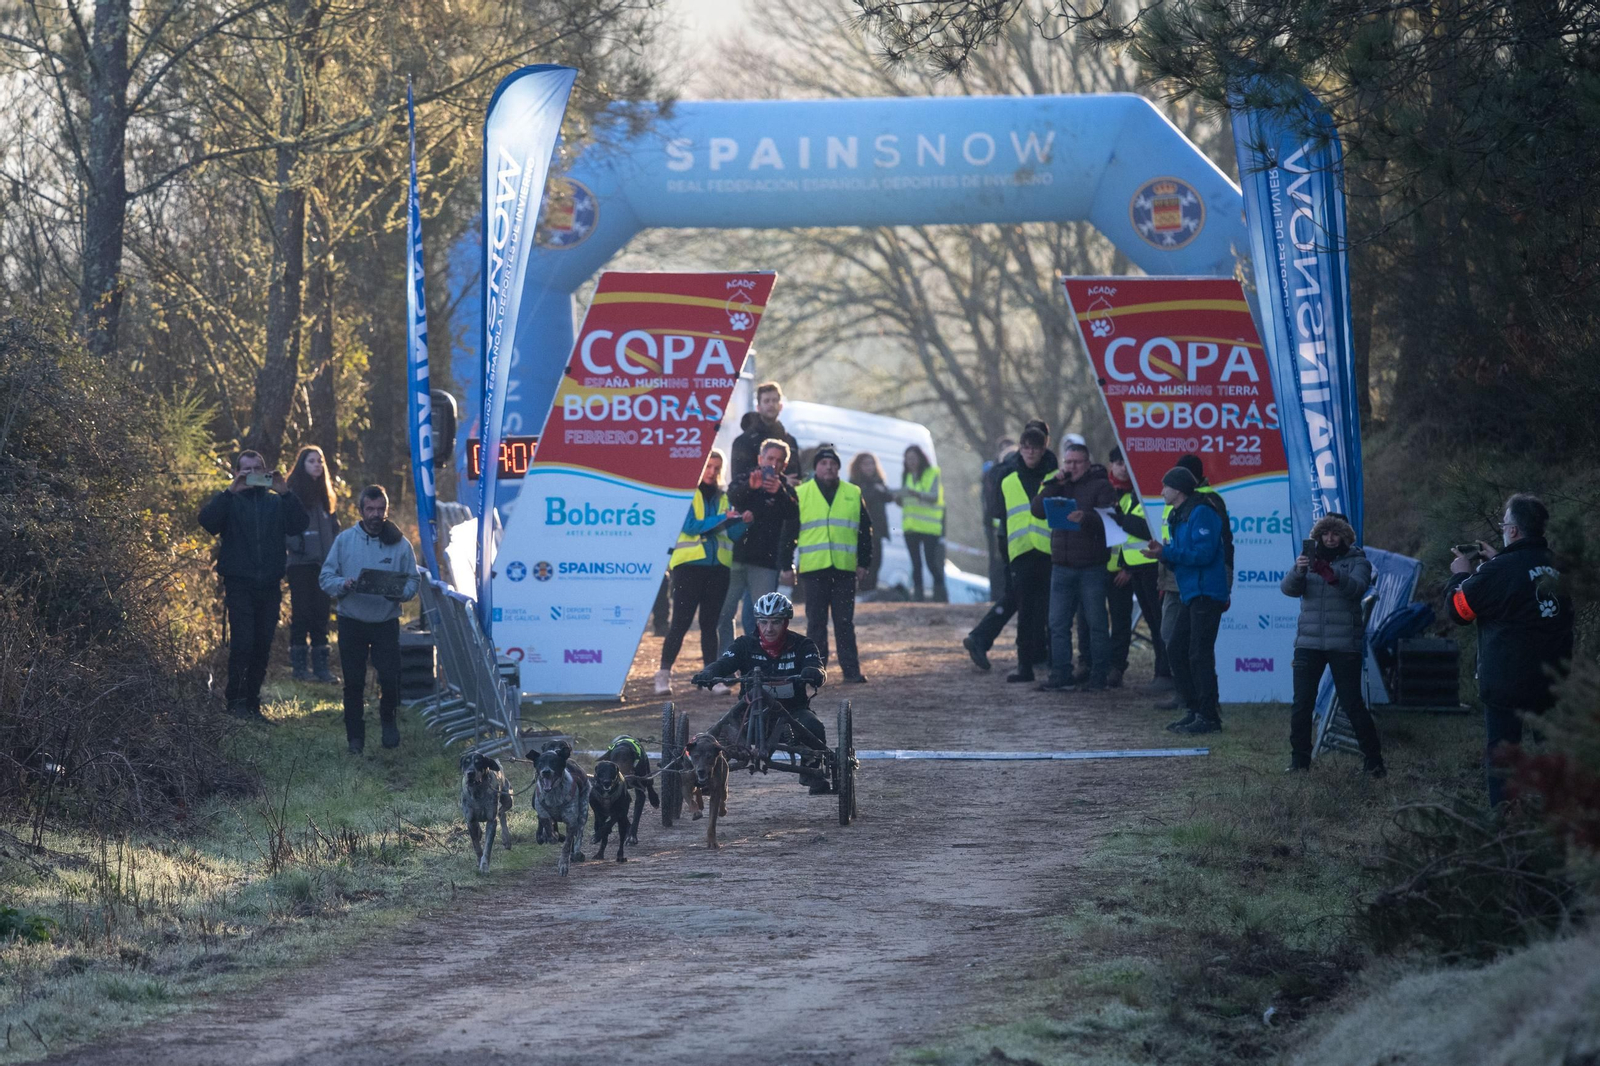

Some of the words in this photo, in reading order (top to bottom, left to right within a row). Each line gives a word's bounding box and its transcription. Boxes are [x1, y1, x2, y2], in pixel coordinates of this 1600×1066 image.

[666, 131, 1056, 172] SPAINSNOW
[514, 156, 536, 222] INVIERNO
[510, 224, 521, 243] DE
[726, 278, 756, 290] ACADE
[1088, 286, 1117, 297] ACADE
[580, 330, 735, 375] COPA
[1104, 336, 1260, 382] COPA
[584, 375, 629, 388] ESPAÑA
[635, 378, 689, 388] MUSHING
[693, 378, 735, 388] TIERRA
[1108, 383, 1154, 395] ESPAÑA
[1159, 385, 1213, 395] MUSHING
[1217, 385, 1259, 395] TIERRA
[563, 391, 723, 421] BOBORÁS
[1125, 400, 1280, 430] BOBORÁS
[564, 430, 638, 445] FEBRERO
[640, 428, 702, 445] 21-22
[1126, 437, 1199, 452] FEBRERO
[1201, 435, 1262, 453] 21-22
[545, 497, 656, 526] Boborás
[558, 562, 653, 575] SPAINSNOW
